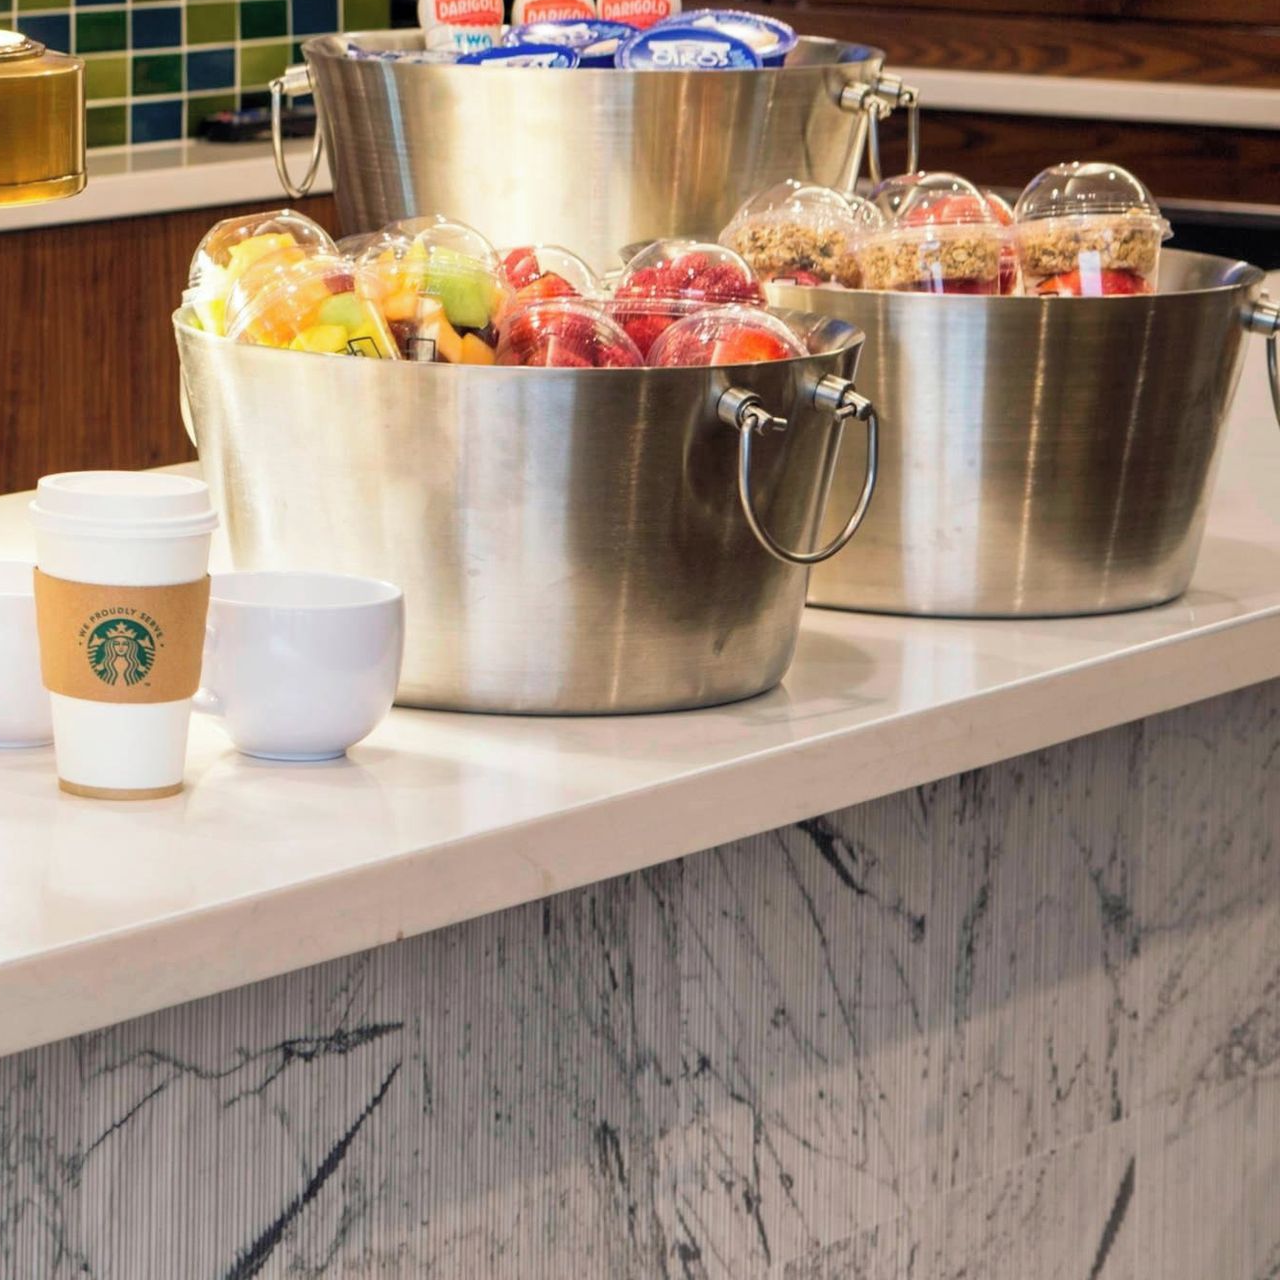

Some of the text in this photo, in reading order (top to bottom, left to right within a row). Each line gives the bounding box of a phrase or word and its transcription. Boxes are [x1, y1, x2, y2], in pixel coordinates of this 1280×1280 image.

[79, 607, 164, 639] WE PROUDLY SERVE
